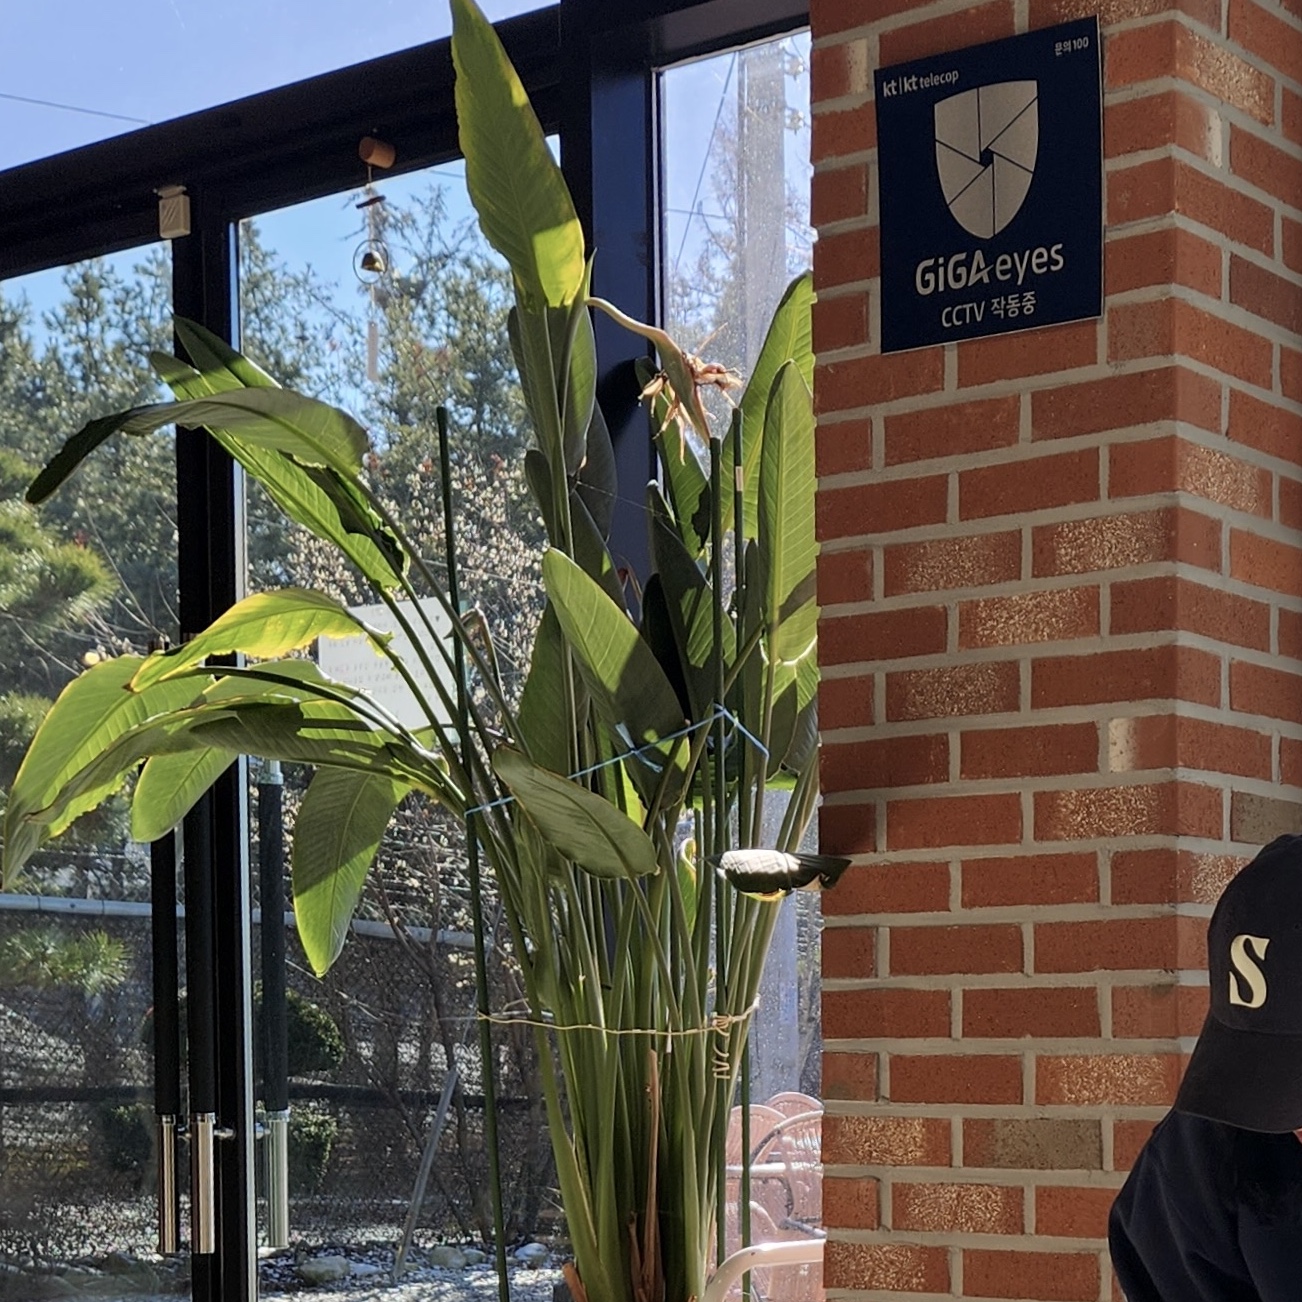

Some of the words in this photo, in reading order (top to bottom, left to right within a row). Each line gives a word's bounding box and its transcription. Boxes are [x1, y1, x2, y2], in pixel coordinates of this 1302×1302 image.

[920, 70, 959, 89] telecop
[941, 301, 985, 328] CCTV
[991, 291, 1037, 319] 작동중
[1229, 934, 1271, 1009] S
